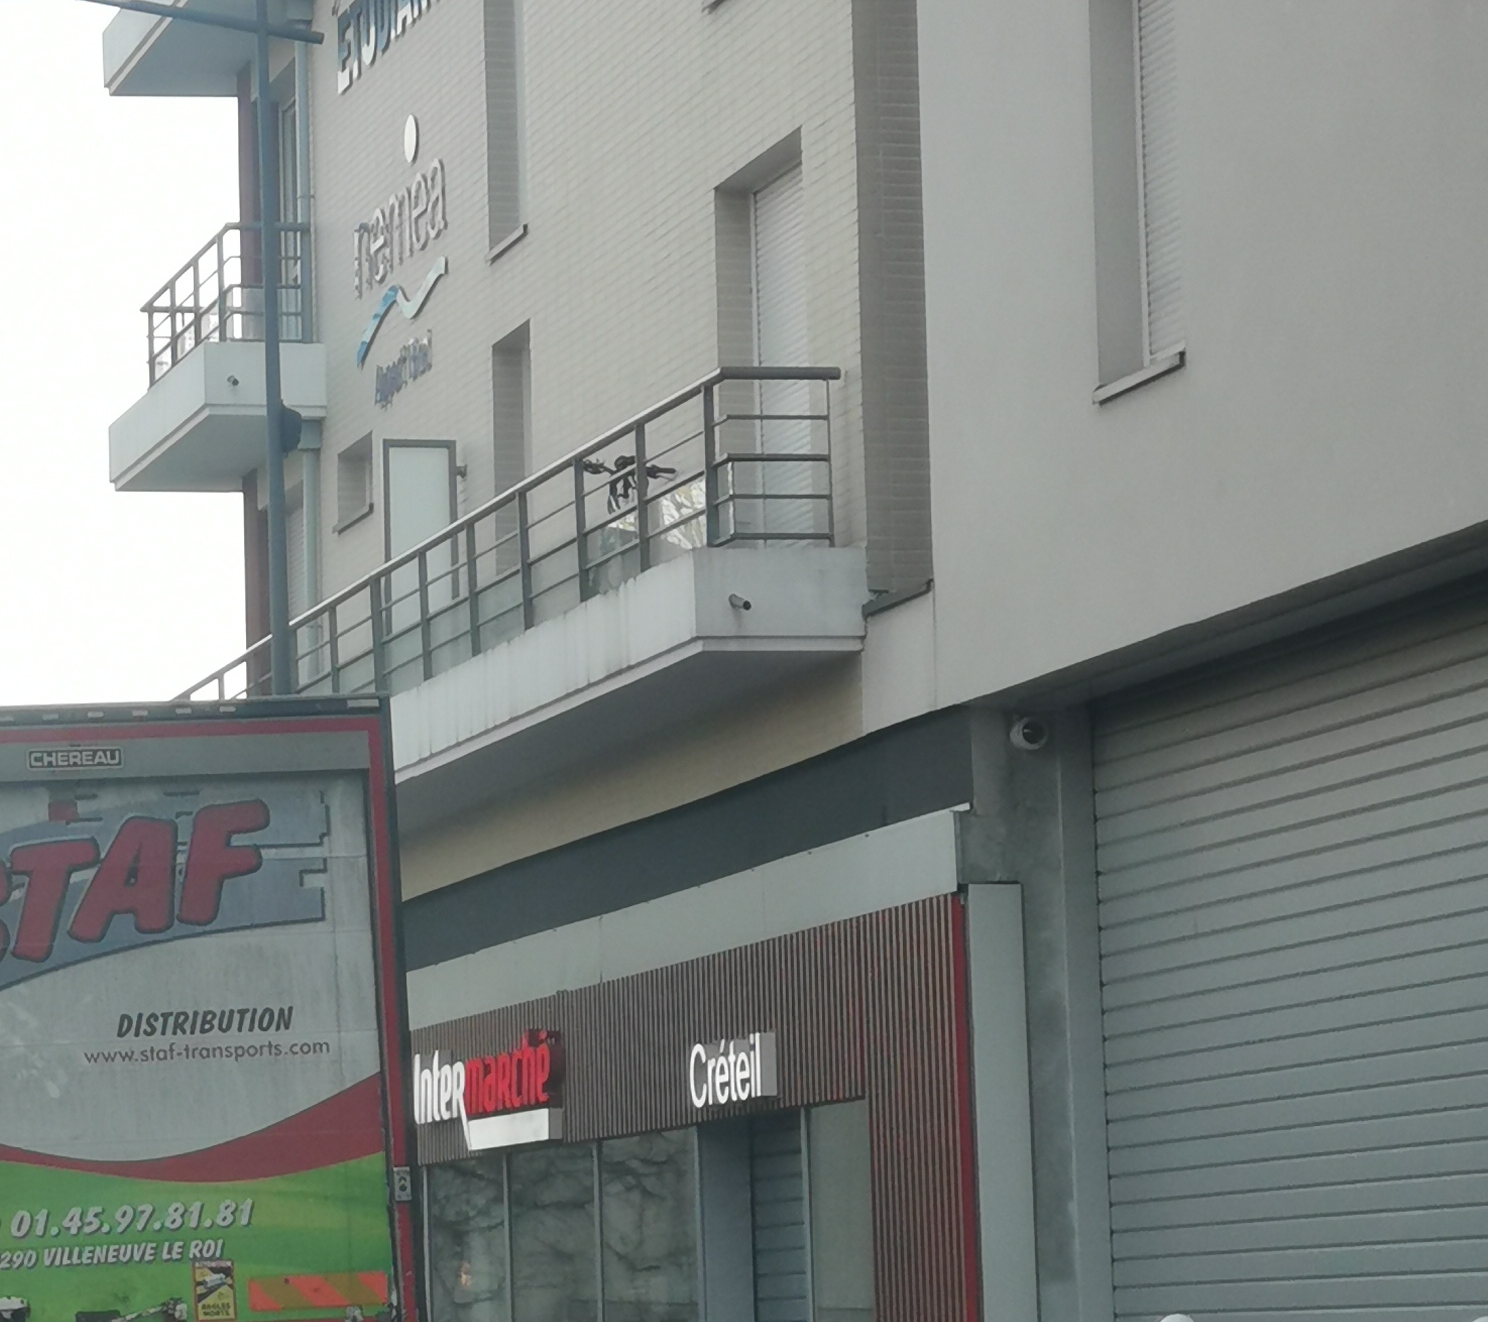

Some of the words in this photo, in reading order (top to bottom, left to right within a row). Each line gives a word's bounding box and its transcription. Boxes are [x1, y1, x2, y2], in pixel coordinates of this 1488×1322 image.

[30, 750, 120, 767] CHEREAU
[116, 1006, 294, 1038] DISTRIBUTION
[83, 1040, 331, 1064] www.staf-transports.com
[689, 1031, 763, 1109] Créteil
[10, 1197, 254, 1238] 01.45.97.81.81
[43, 1242, 157, 1267] VILLENEUVE
[162, 1241, 185, 1261] LE
[189, 1238, 224, 1260] ROI
